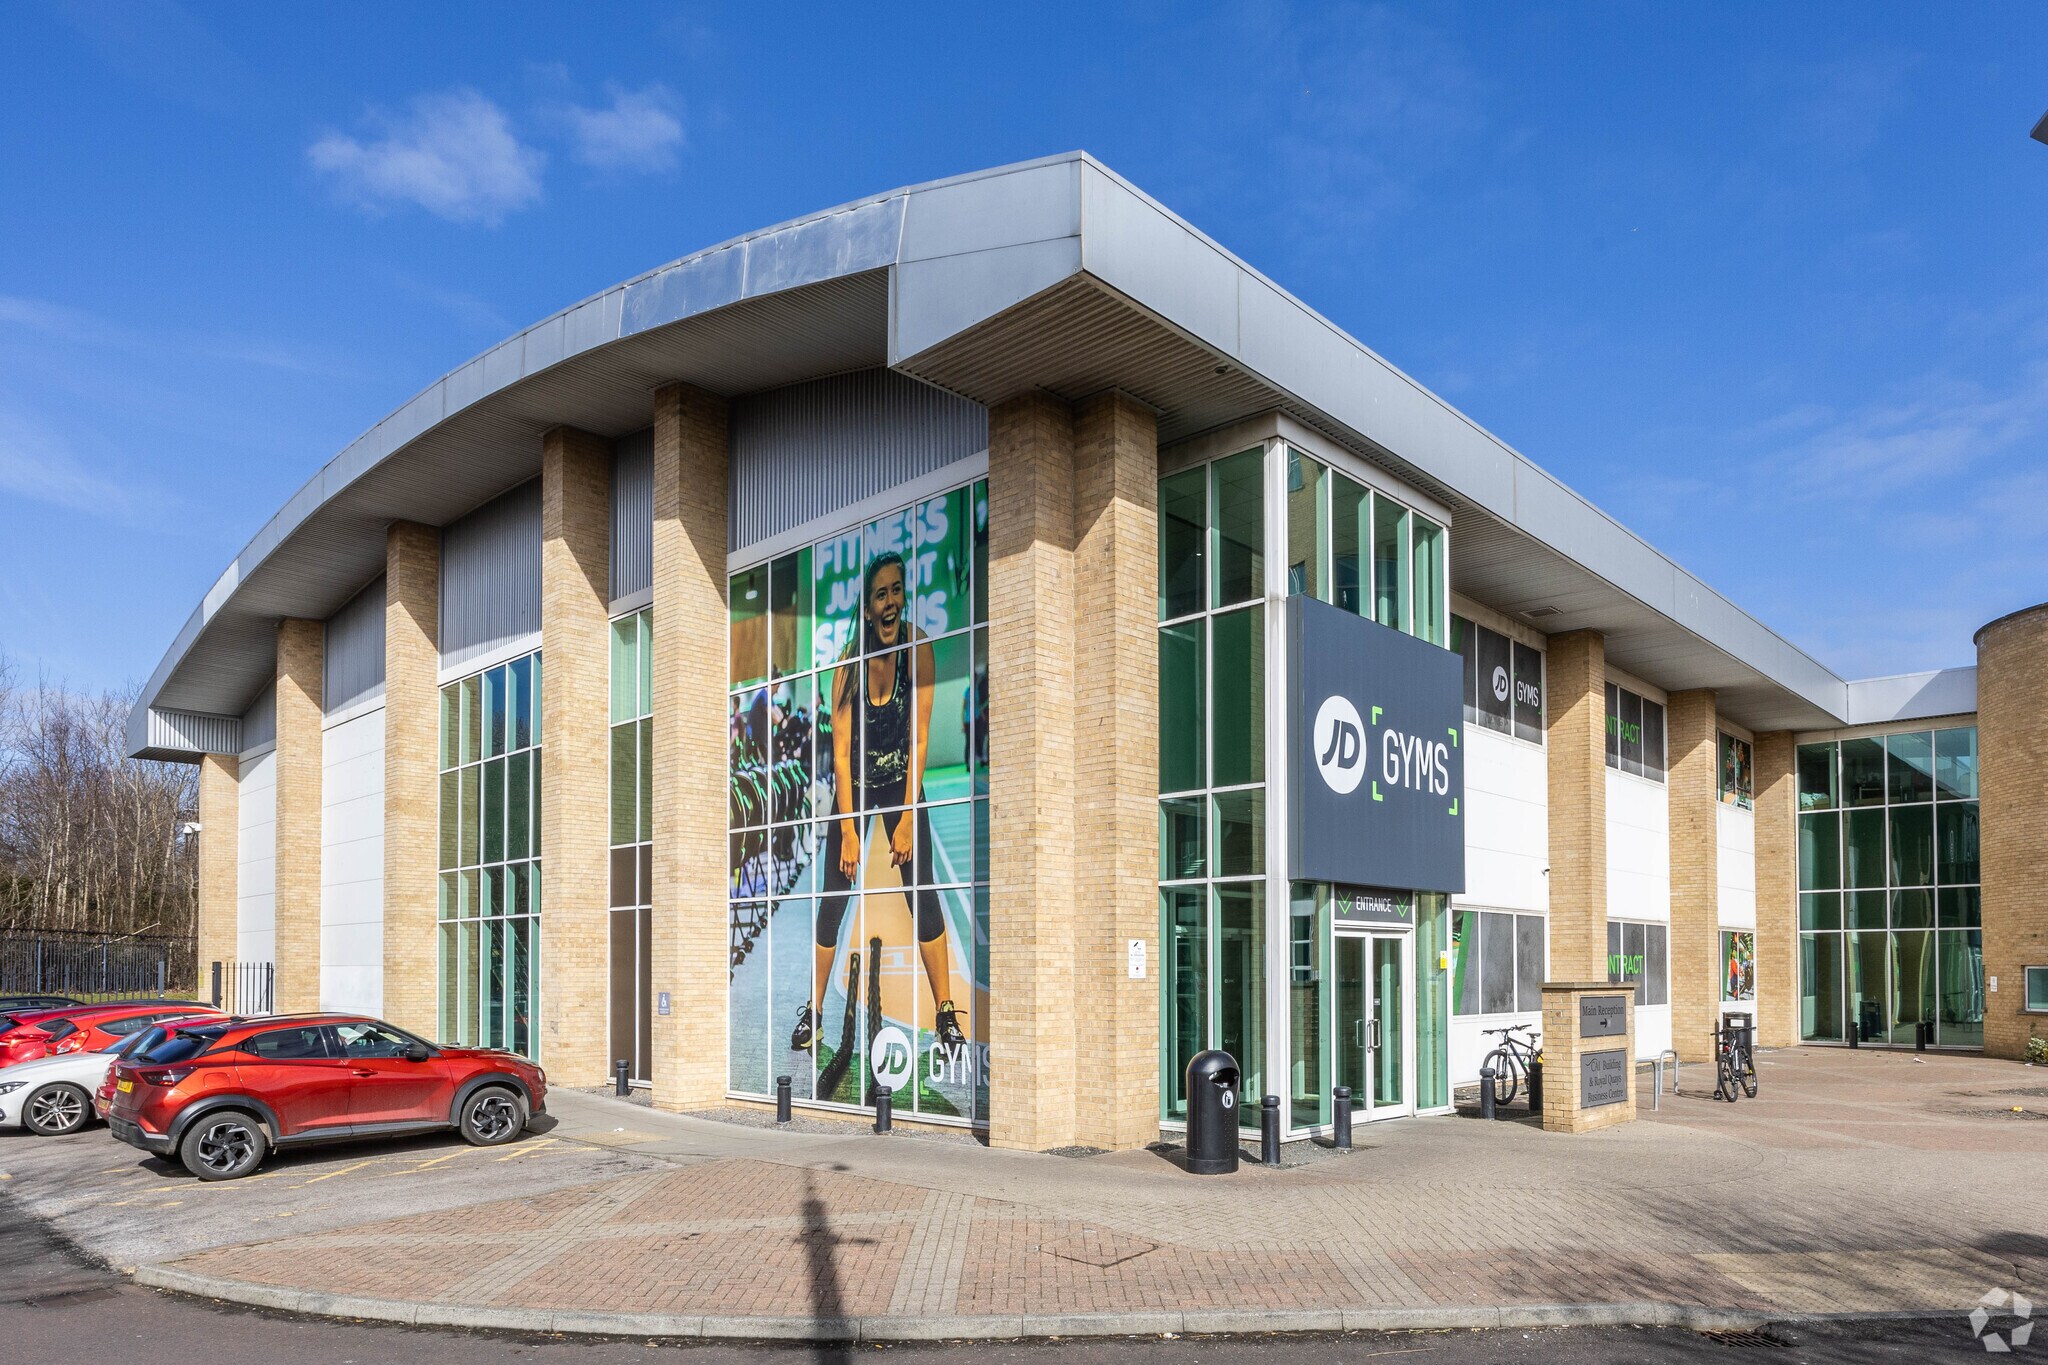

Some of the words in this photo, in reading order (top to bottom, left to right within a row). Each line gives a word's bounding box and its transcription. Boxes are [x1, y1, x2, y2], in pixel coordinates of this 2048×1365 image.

[816, 496, 948, 580] FITNESS
[1517, 680, 1539, 707] GYMS
[1321, 719, 1361, 769] JD
[1382, 729, 1449, 796] GYMS
[1356, 896, 1392, 913] ENTRANCE
[1582, 1005, 1597, 1017] Main
[1598, 1005, 1625, 1019] Reception
[877, 1042, 908, 1074] JD
[1603, 1059, 1622, 1072] Building
[1594, 1076, 1608, 1088] Royal
[1608, 1073, 1622, 1087] Quays
[1587, 1091, 1609, 1103] Business
[1609, 1088, 1624, 1100] Centre
